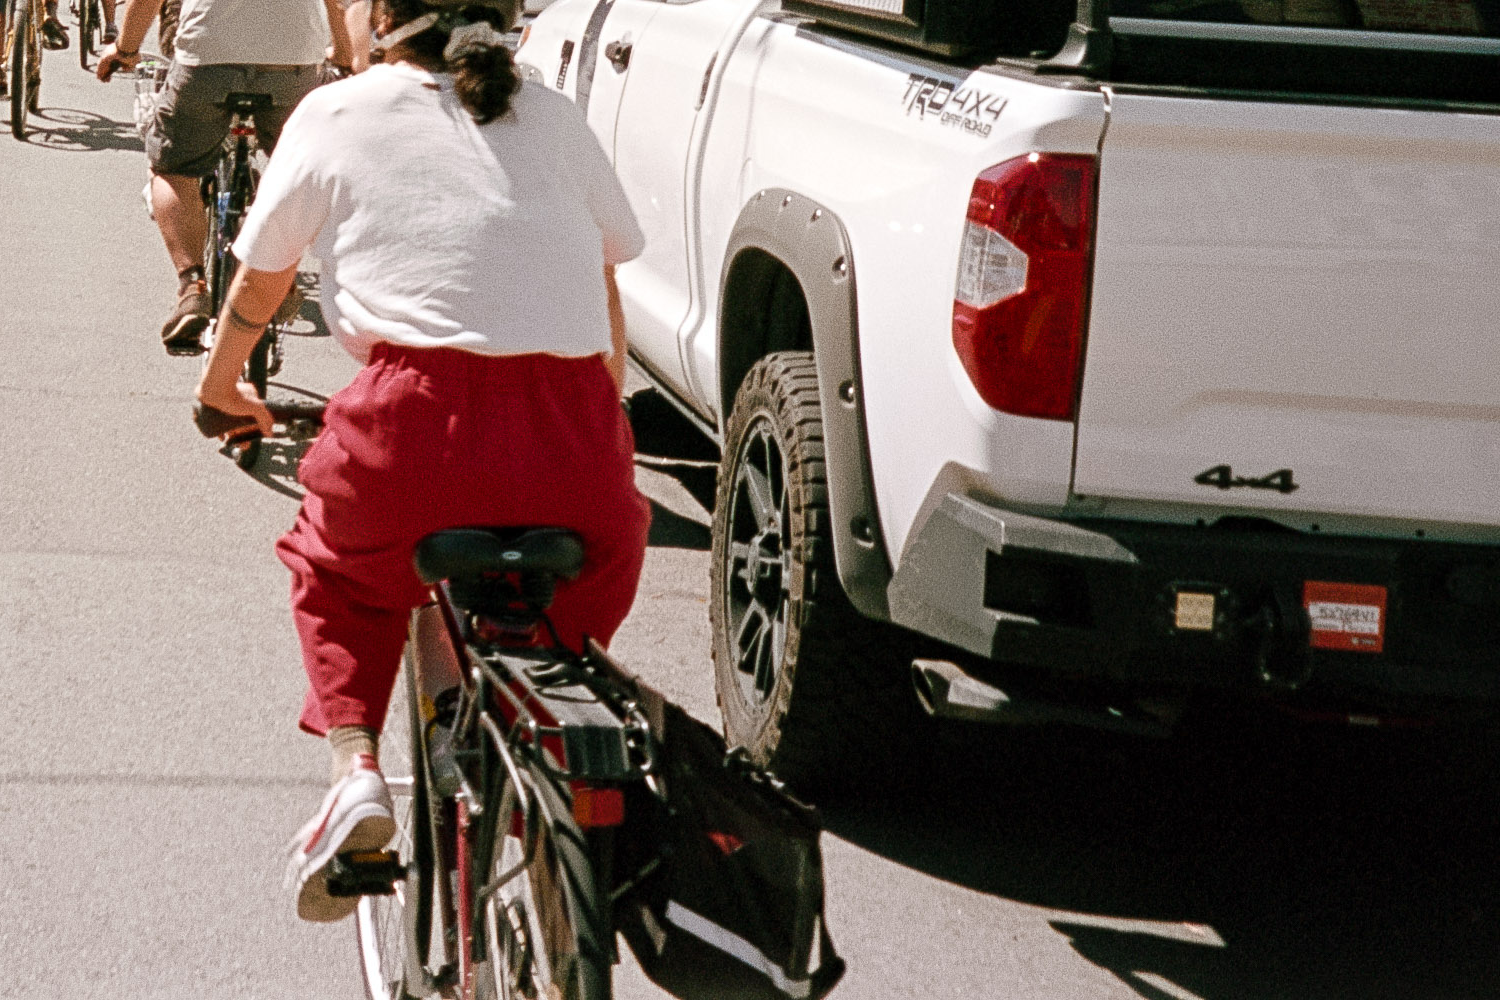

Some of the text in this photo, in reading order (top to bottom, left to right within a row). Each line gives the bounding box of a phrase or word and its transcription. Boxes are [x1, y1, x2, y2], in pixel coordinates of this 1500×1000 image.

[902, 73, 1009, 120] TRD 4X4
[941, 112, 992, 137] OFF ROAD
